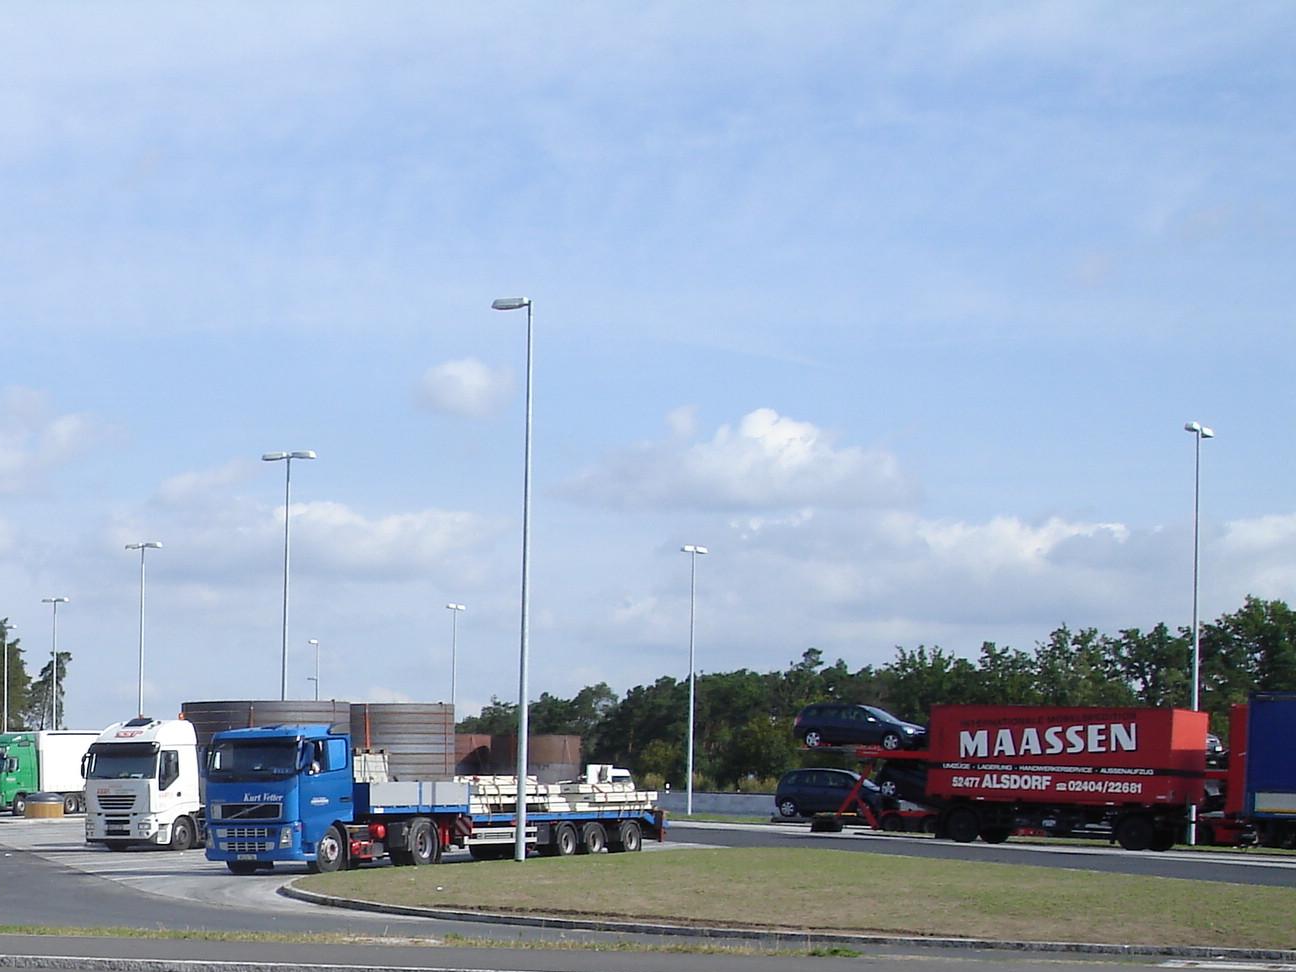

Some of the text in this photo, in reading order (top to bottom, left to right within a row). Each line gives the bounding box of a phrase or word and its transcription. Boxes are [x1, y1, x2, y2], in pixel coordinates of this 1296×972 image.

[959, 723, 1136, 758] MAASSEN
[952, 774, 1142, 793] 52477 ALSDORF 02404/22681
[244, 793, 261, 802] Kurt
